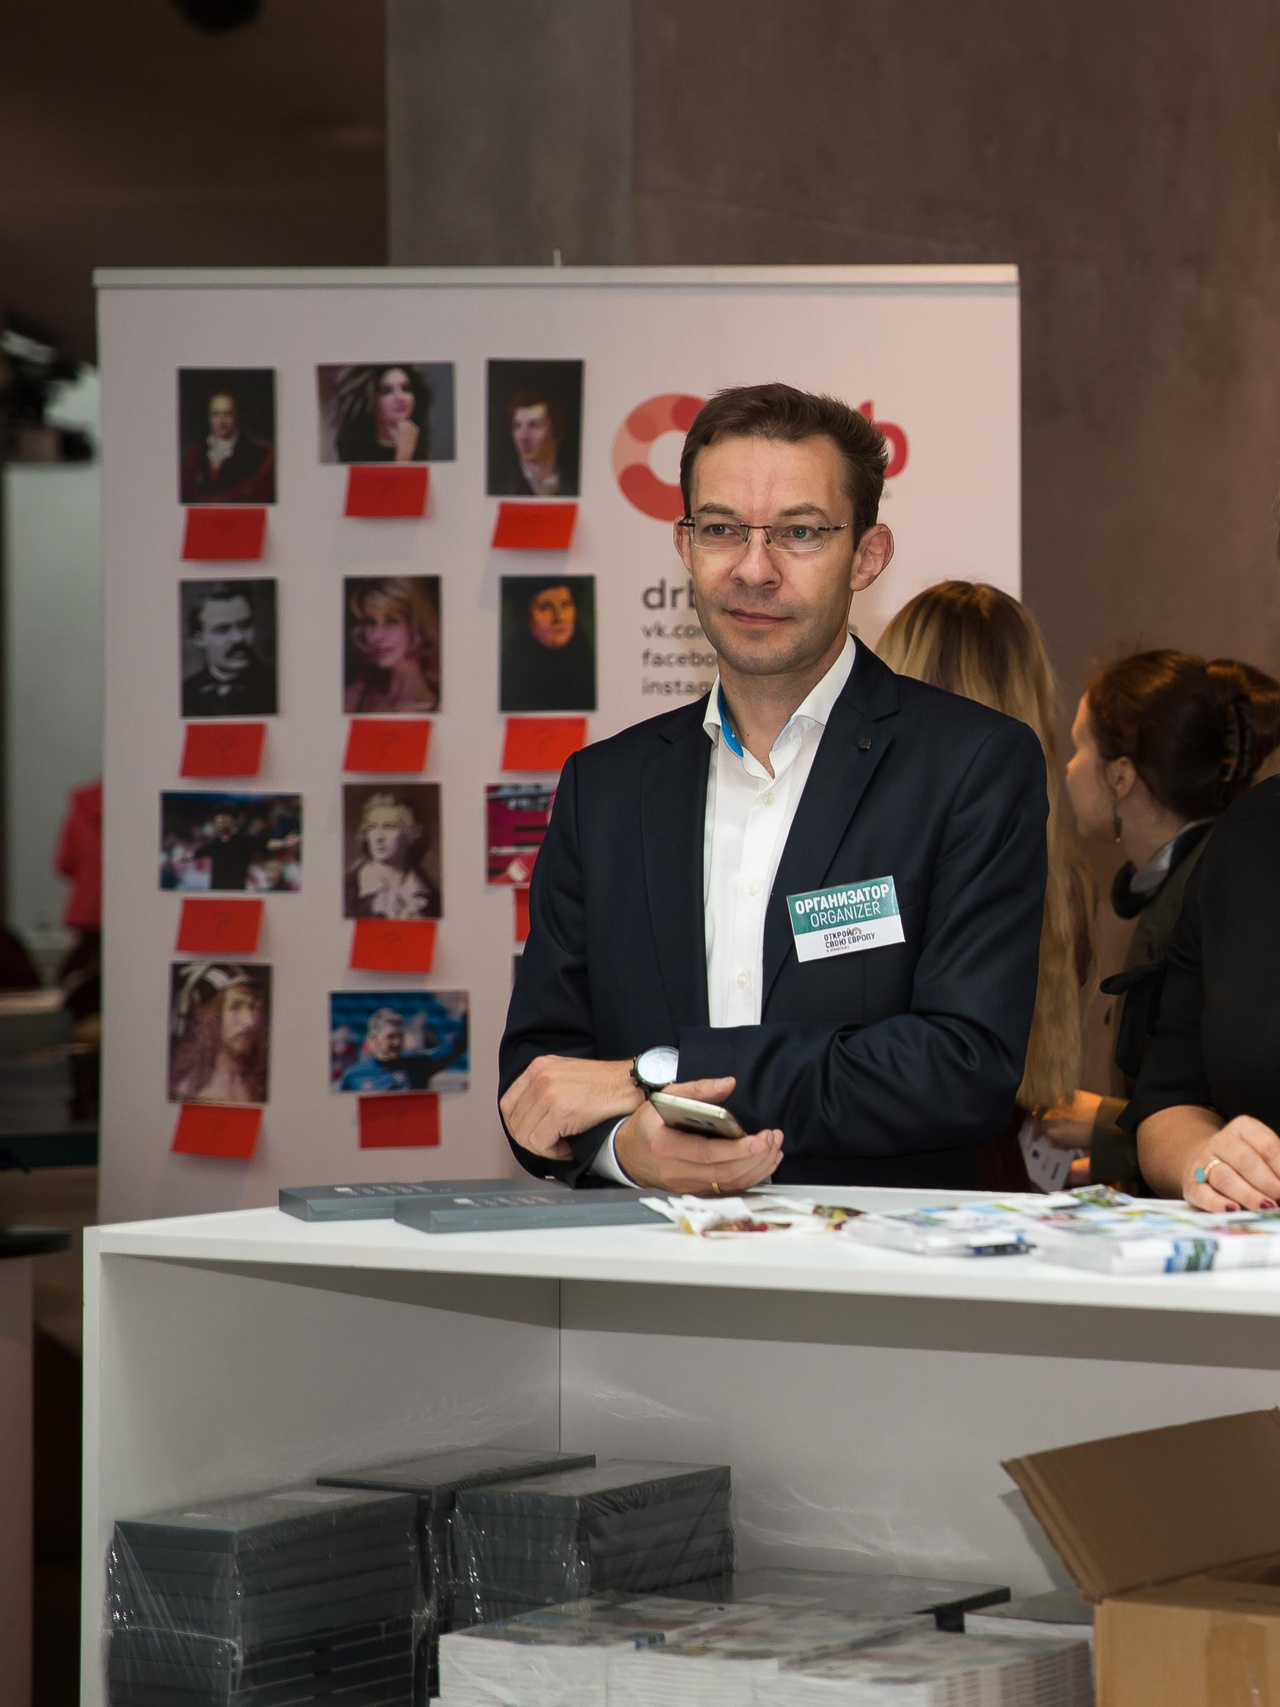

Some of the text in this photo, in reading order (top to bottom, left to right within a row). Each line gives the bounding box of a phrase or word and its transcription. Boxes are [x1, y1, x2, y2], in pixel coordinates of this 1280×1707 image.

[795, 883, 889, 914] ОРГАНИЗАТОР
[810, 901, 881, 927] ORGANIZER
[824, 928, 853, 941] ОТКРОЙ
[825, 932, 875, 948] СВОЮ ЕВРОПУ
